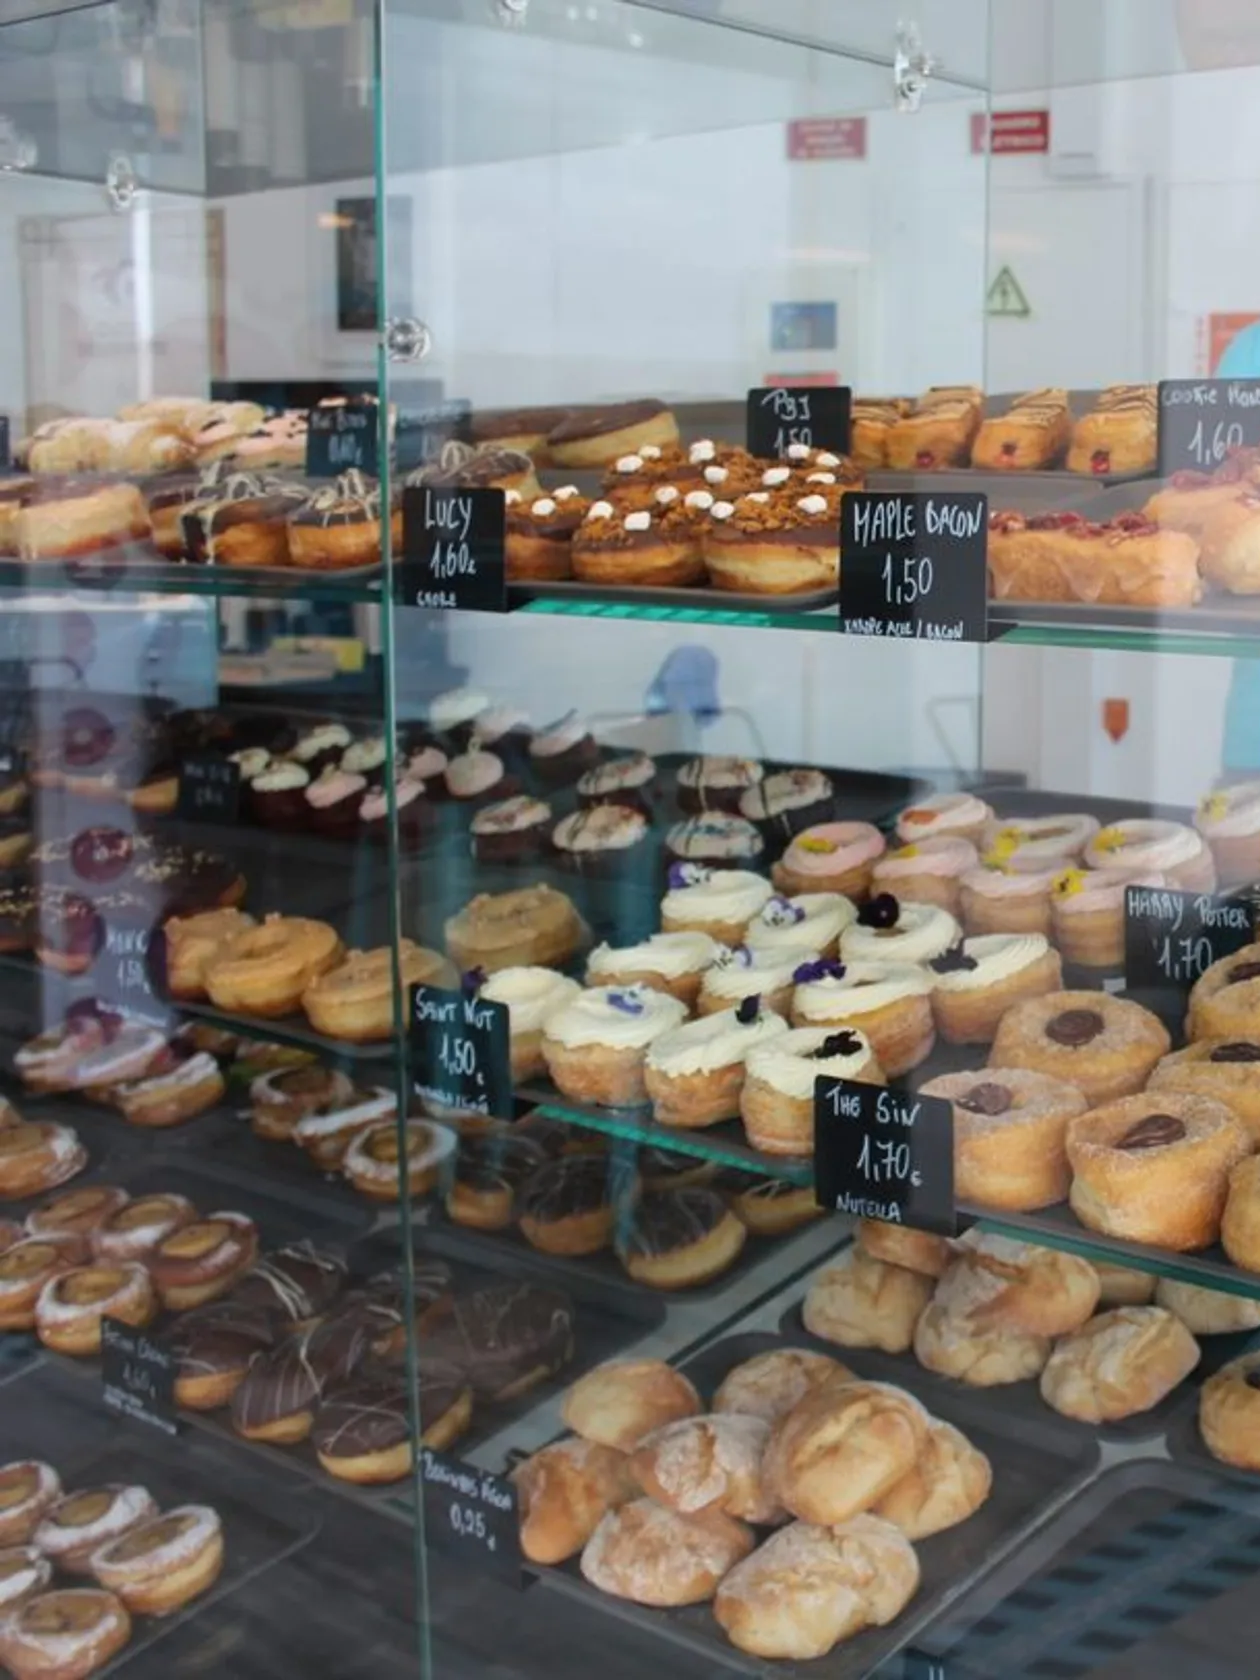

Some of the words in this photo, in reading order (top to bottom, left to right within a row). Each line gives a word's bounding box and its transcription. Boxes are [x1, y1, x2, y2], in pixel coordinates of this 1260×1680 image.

[1162, 385, 1218, 406] COOKIE
[425, 489, 472, 541] LUCY
[854, 498, 916, 548] MAPLE
[925, 500, 983, 537] BACON
[881, 552, 933, 604] 1,50
[1128, 889, 1184, 932] HARRY
[1193, 896, 1250, 929] POTTER
[1158, 936, 1213, 980] 1,70
[826, 1080, 861, 1118] THE
[836, 1192, 901, 1222] NUTELLA
